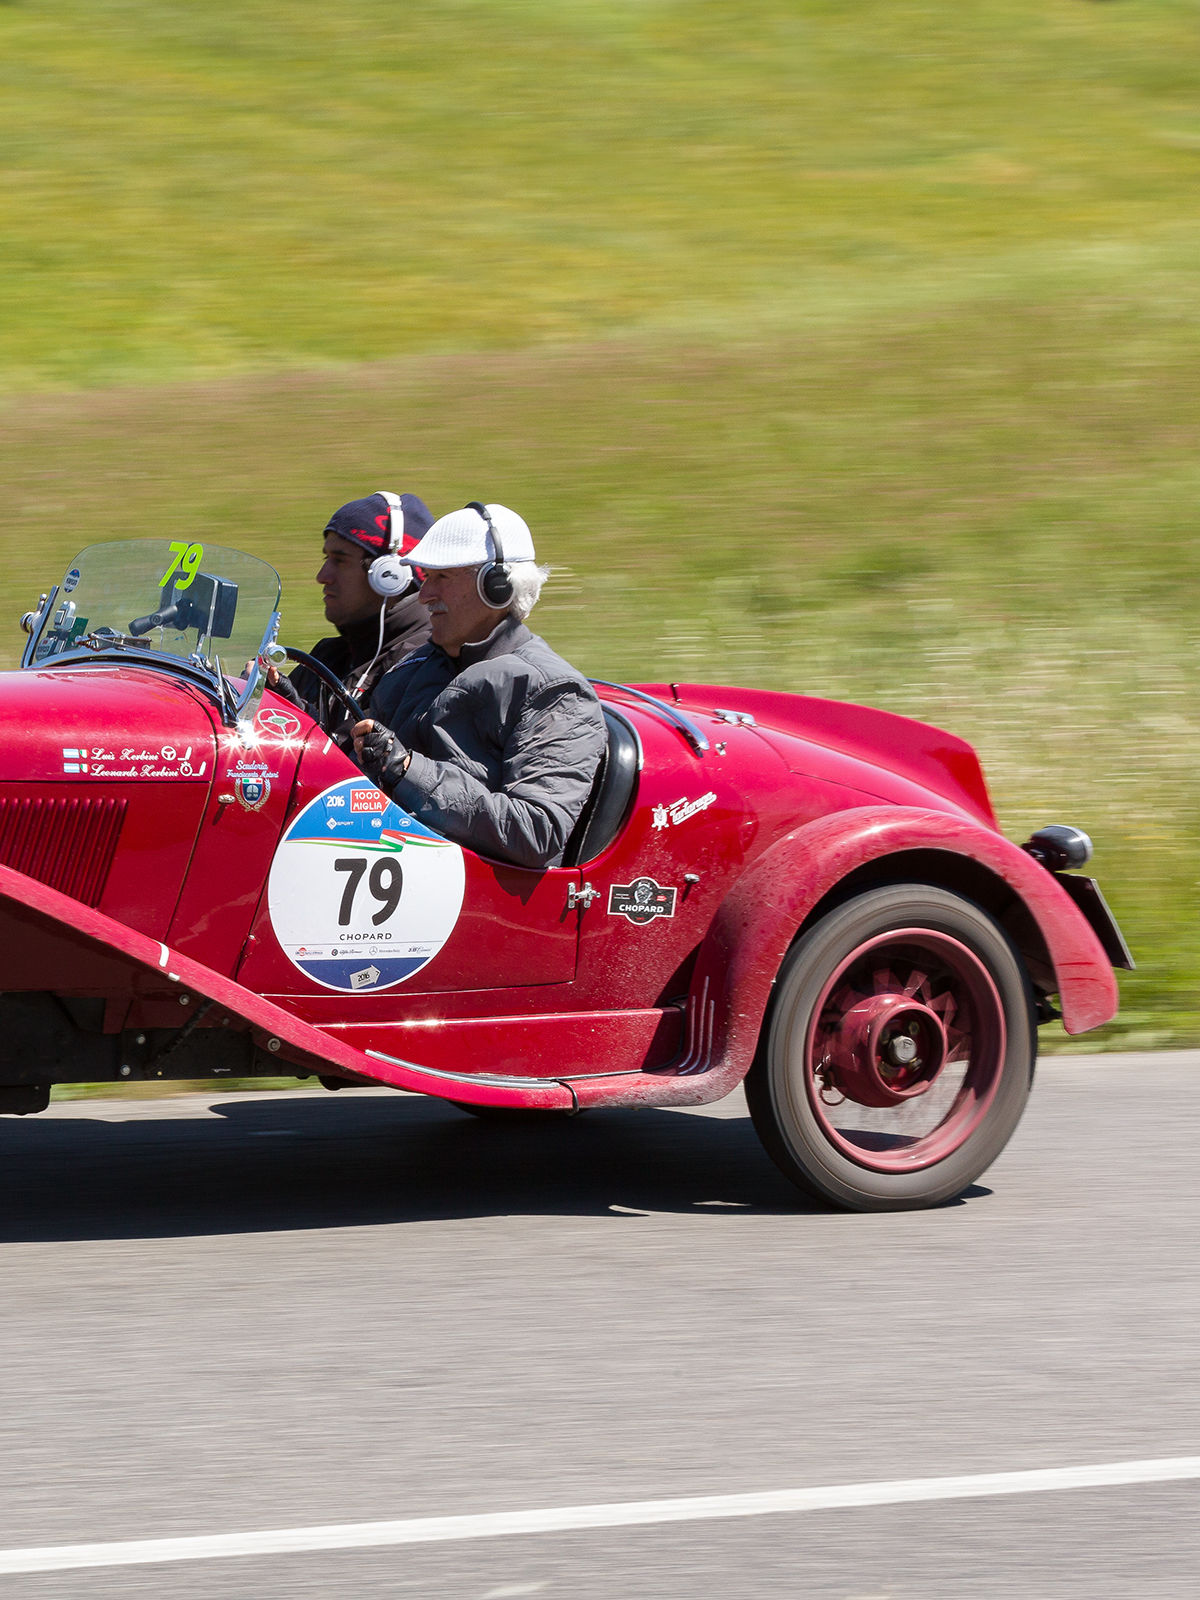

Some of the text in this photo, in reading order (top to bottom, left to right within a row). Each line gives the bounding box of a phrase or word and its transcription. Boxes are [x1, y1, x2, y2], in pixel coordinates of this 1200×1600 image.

[158, 541, 204, 590] 79
[90, 763, 179, 777] Leonardo Zerbini
[326, 795, 345, 807] 2016
[354, 791, 380, 800] 1000
[353, 801, 382, 811] MIGLIA
[334, 856, 403, 927] 79
[618, 903, 665, 913] CHOPARD
[339, 932, 393, 941] CHOPARD
